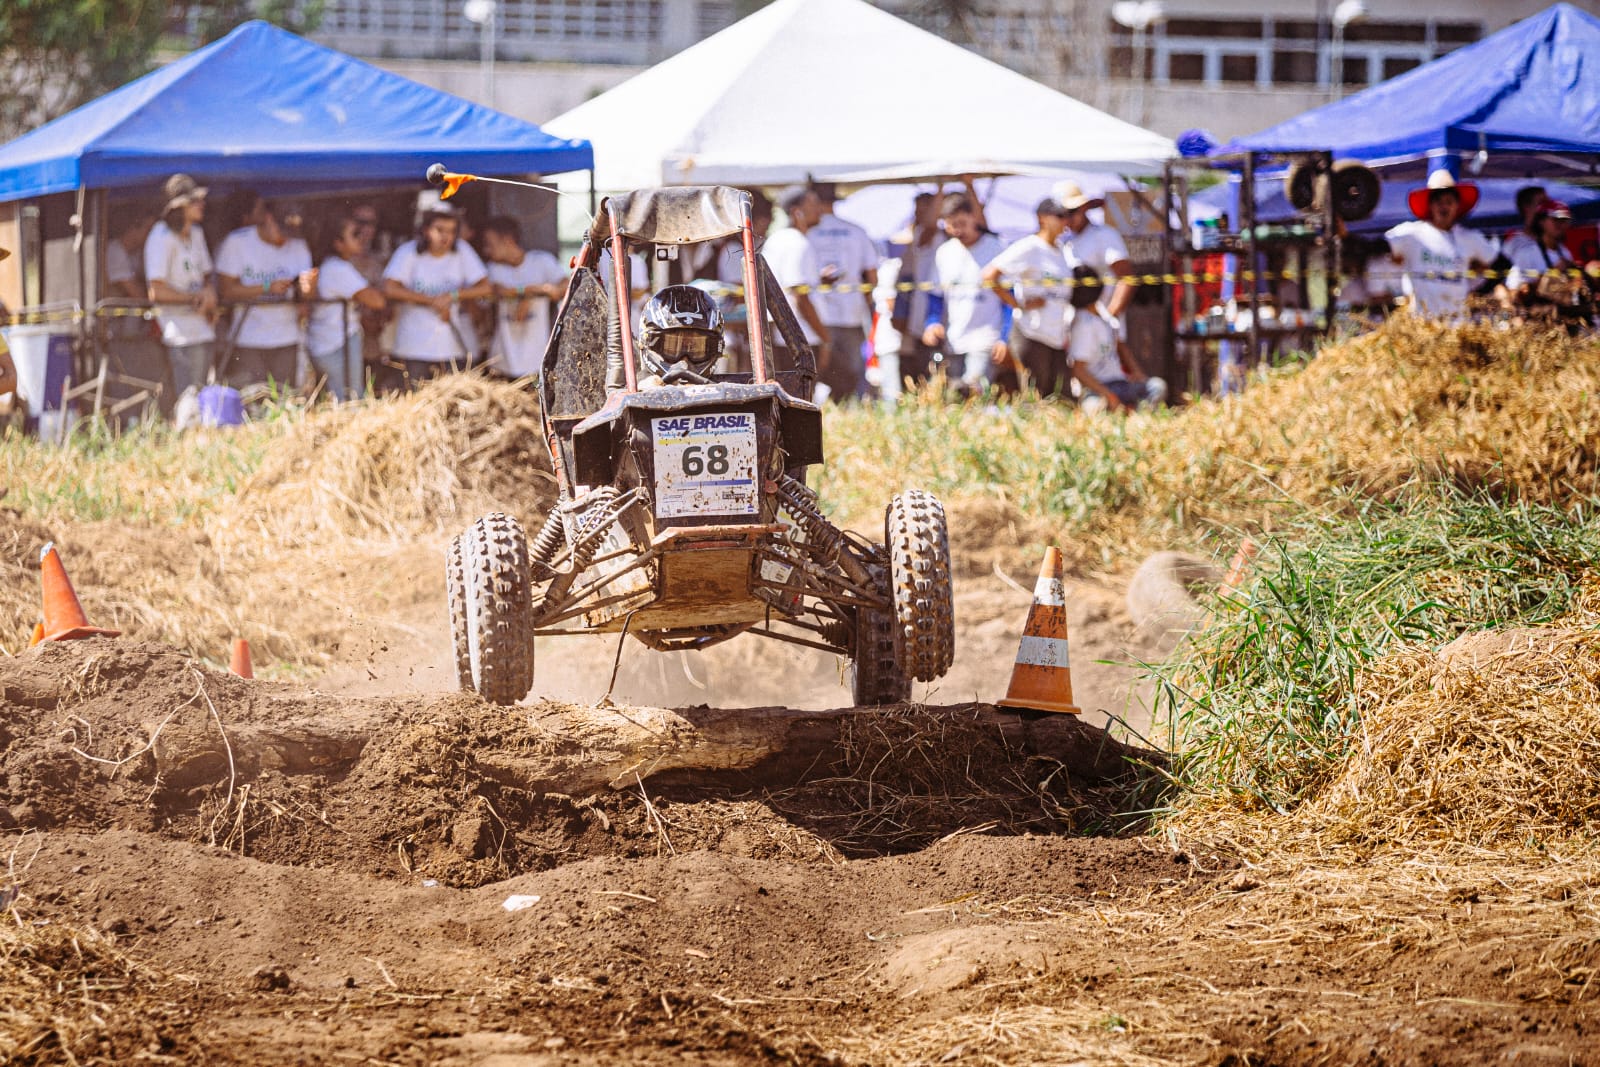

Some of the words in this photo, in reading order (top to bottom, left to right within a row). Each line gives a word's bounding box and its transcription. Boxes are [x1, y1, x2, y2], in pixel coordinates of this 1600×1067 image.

[658, 418, 690, 431] SAE
[694, 416, 749, 429] BRASIL
[682, 445, 729, 476] 68
